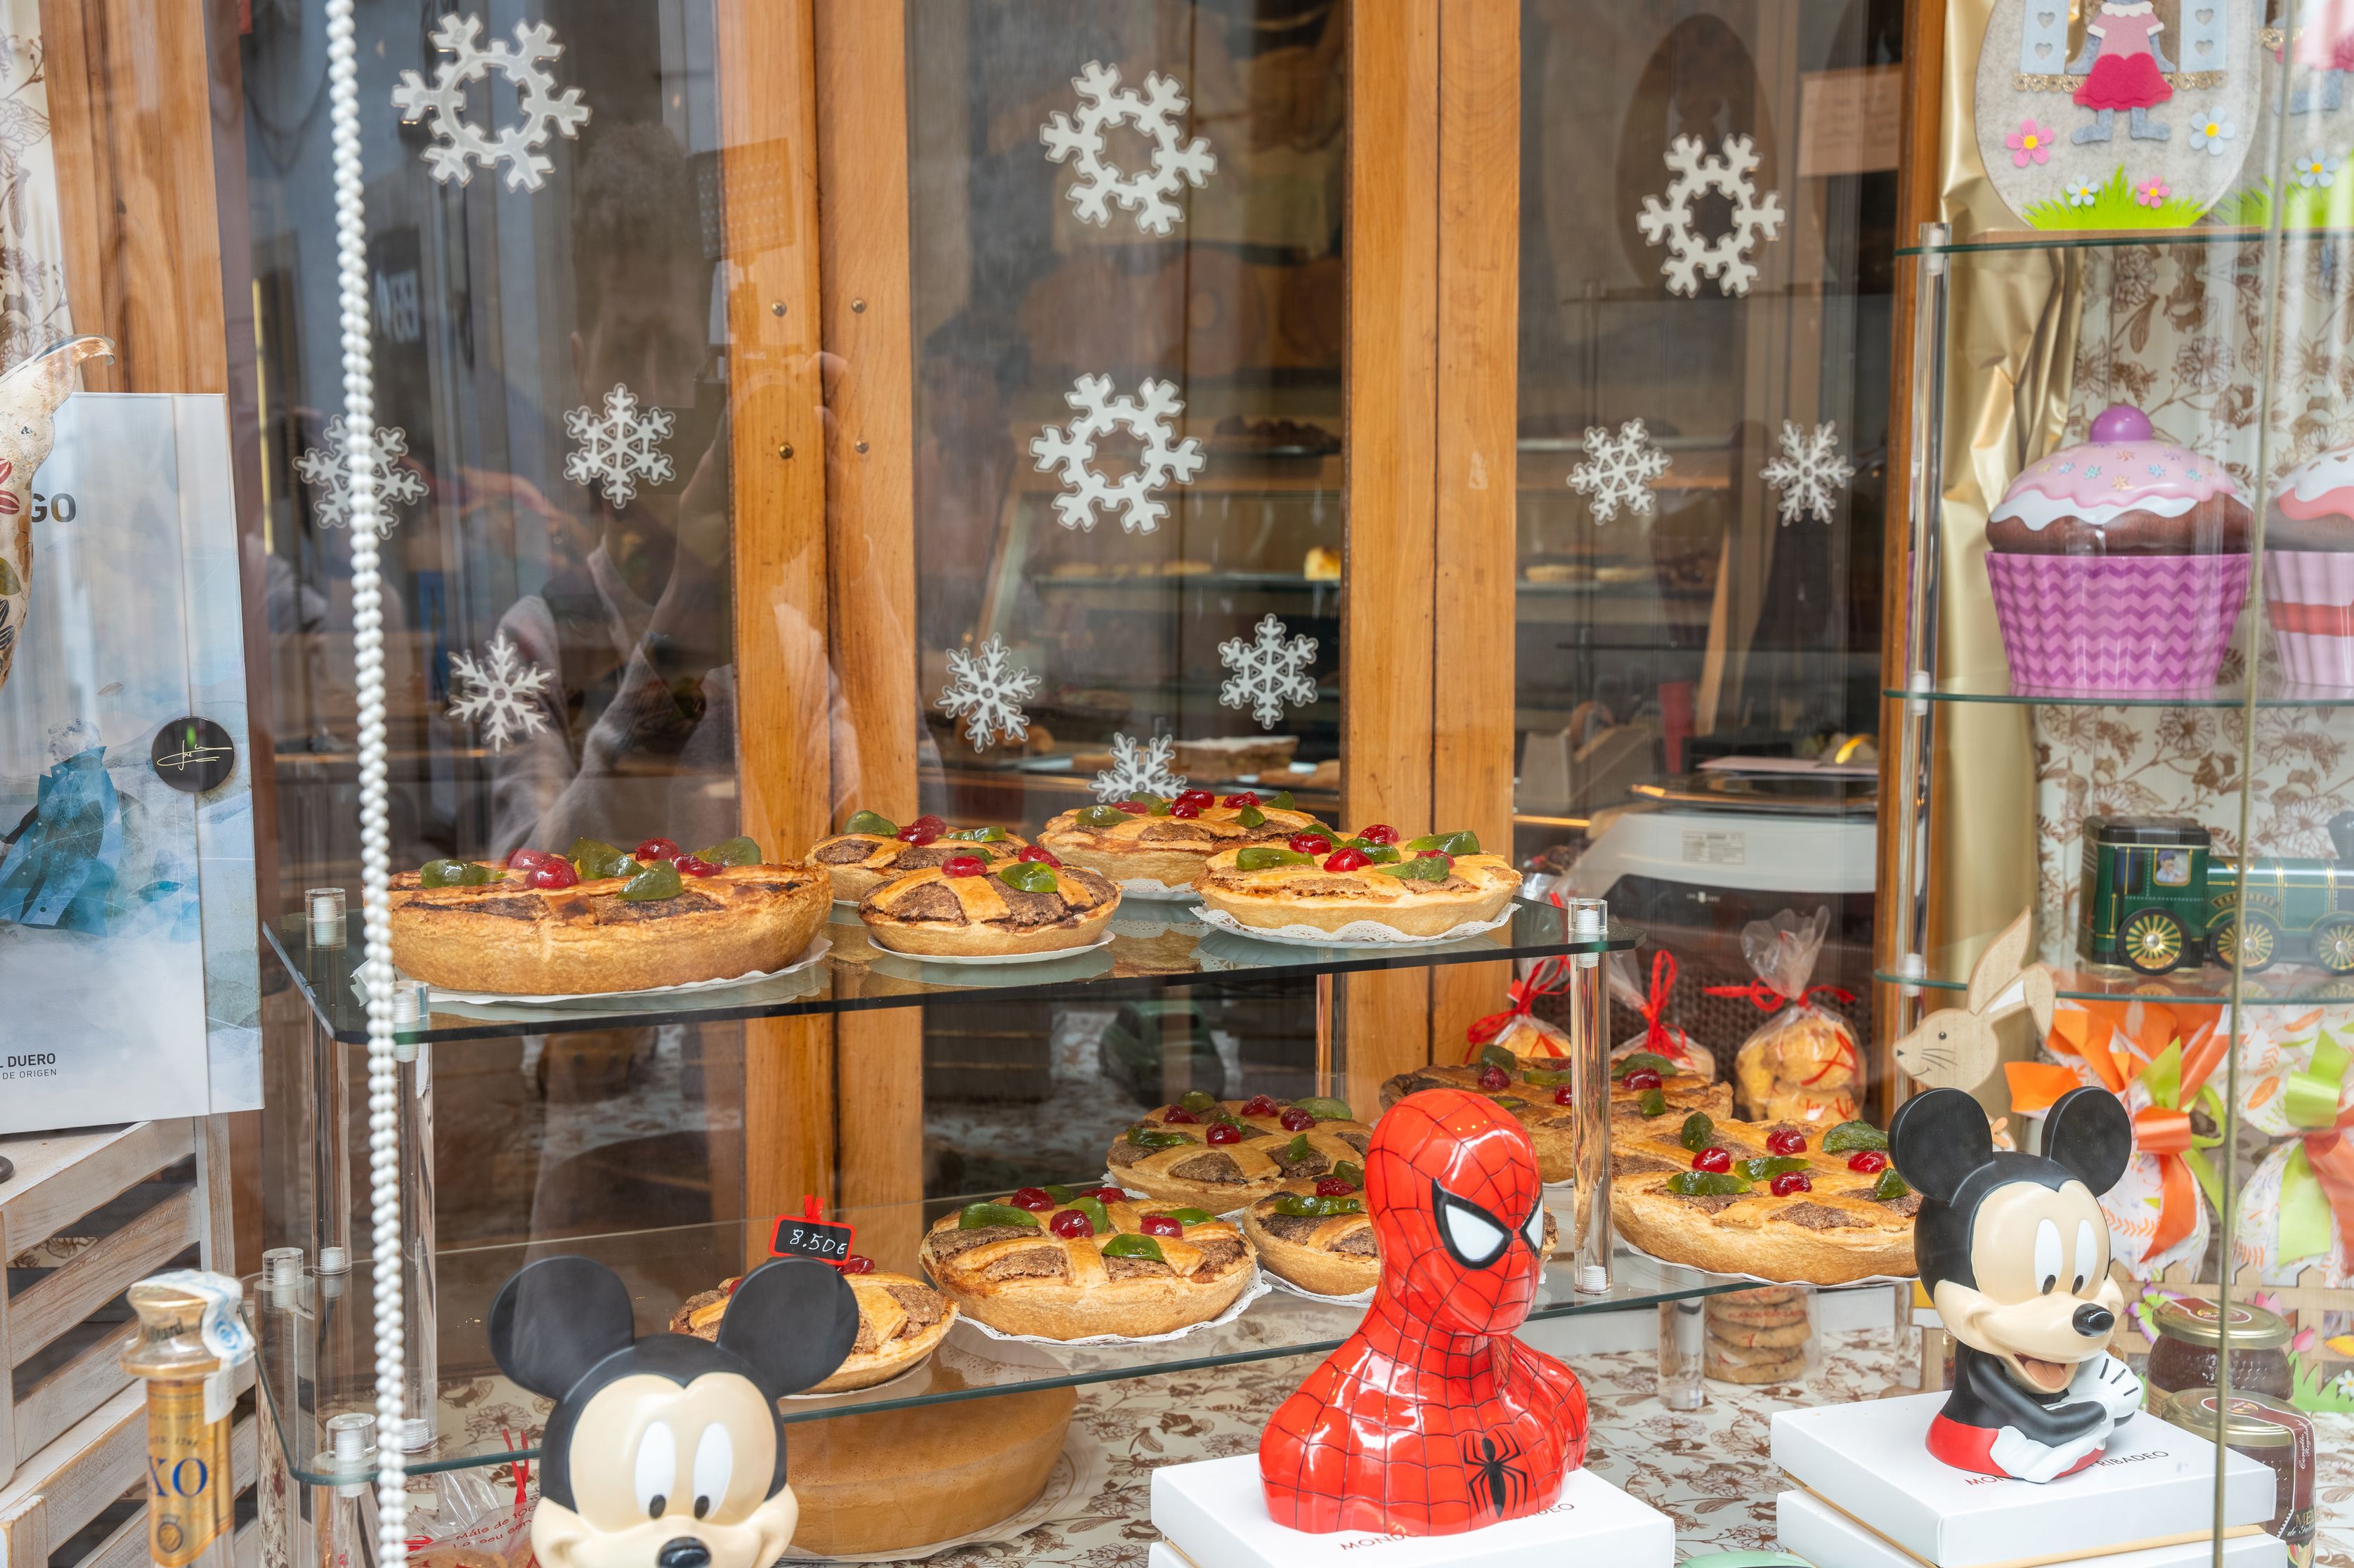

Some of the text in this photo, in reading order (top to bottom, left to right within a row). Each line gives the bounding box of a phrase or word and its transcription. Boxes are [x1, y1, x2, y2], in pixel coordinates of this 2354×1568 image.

[7, 1052, 56, 1068] DUERO
[2, 1069, 57, 1080] DE ORIGEN
[2095, 1451, 2169, 1467] RIBADEO
[494, 1518, 509, 1529] de
[479, 1534, 503, 1544] seu
[1340, 1533, 1419, 1550] MOND
